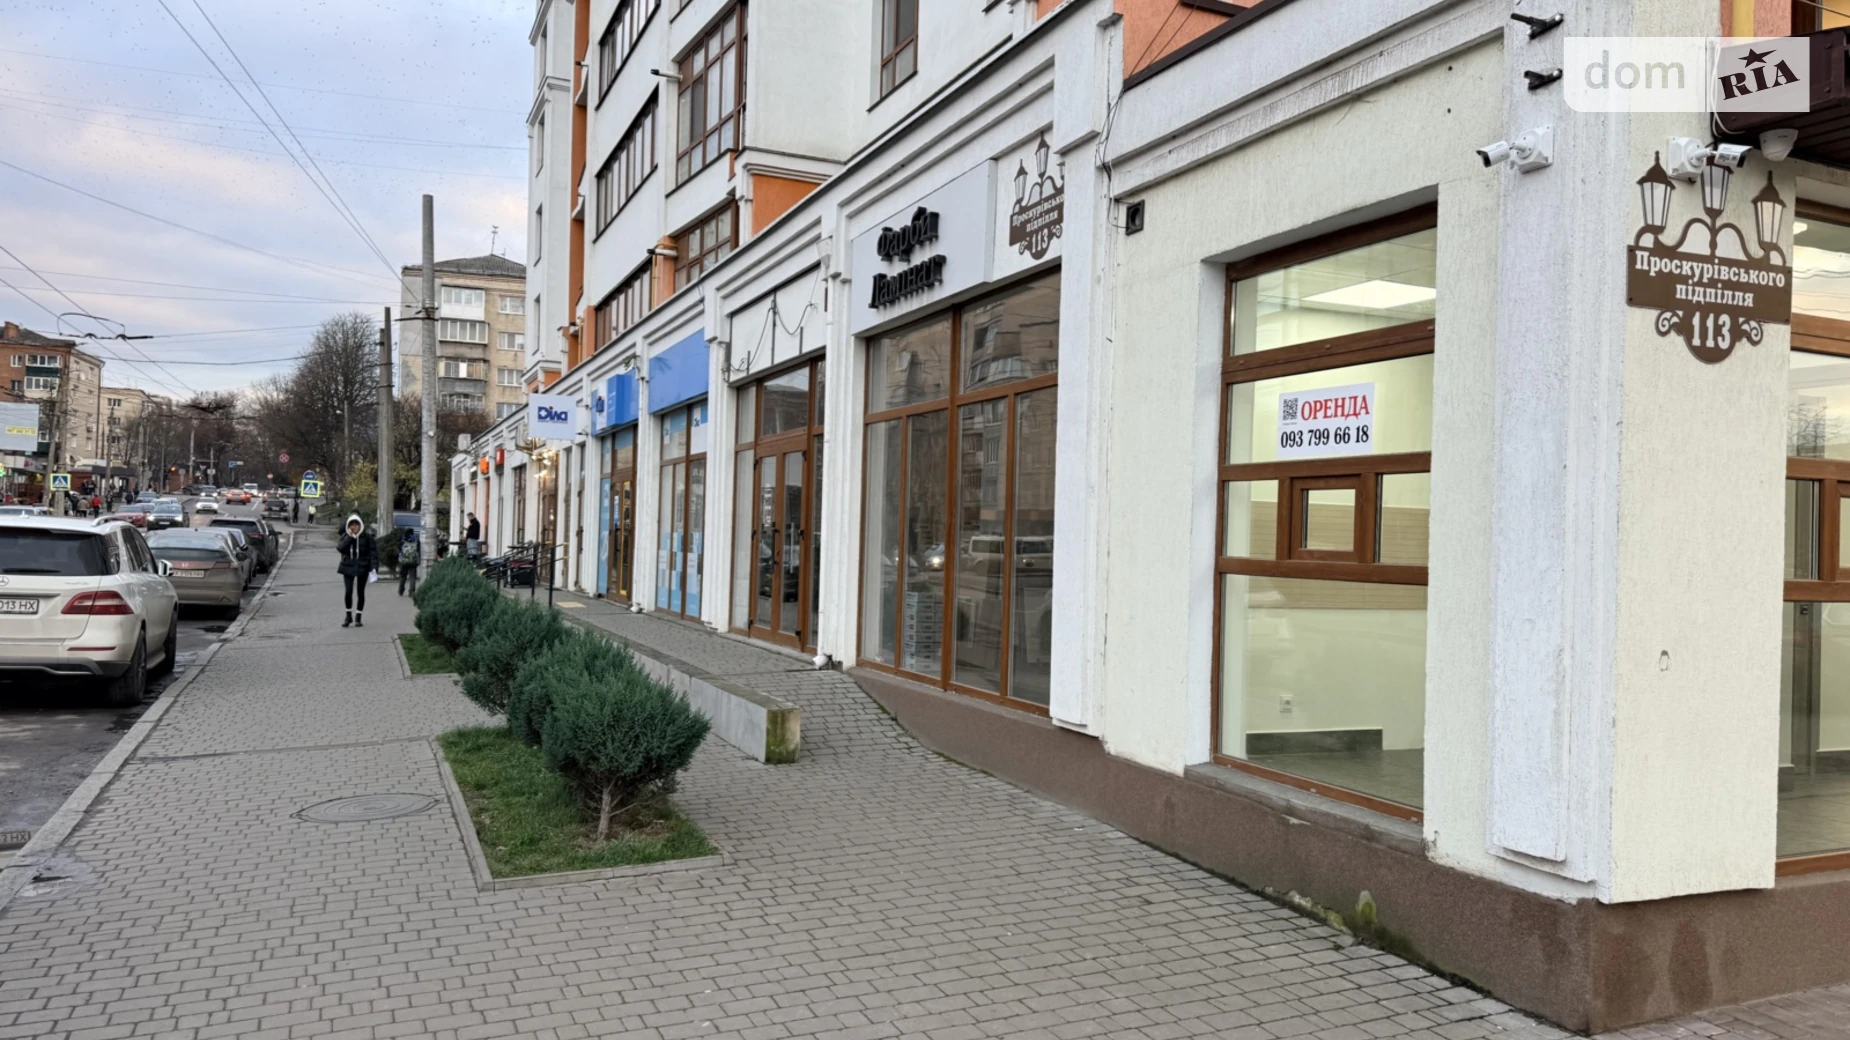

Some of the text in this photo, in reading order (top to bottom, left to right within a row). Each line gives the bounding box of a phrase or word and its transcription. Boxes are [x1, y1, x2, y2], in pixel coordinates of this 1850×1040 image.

[1031, 228, 1049, 253] 113
[1635, 250, 1785, 288] Проскурівського
[1675, 279, 1754, 307] підпілля
[1692, 311, 1731, 350] 113
[1301, 394, 1370, 421] ОРЕНДА
[1280, 424, 1369, 448] 093 799 66 18
